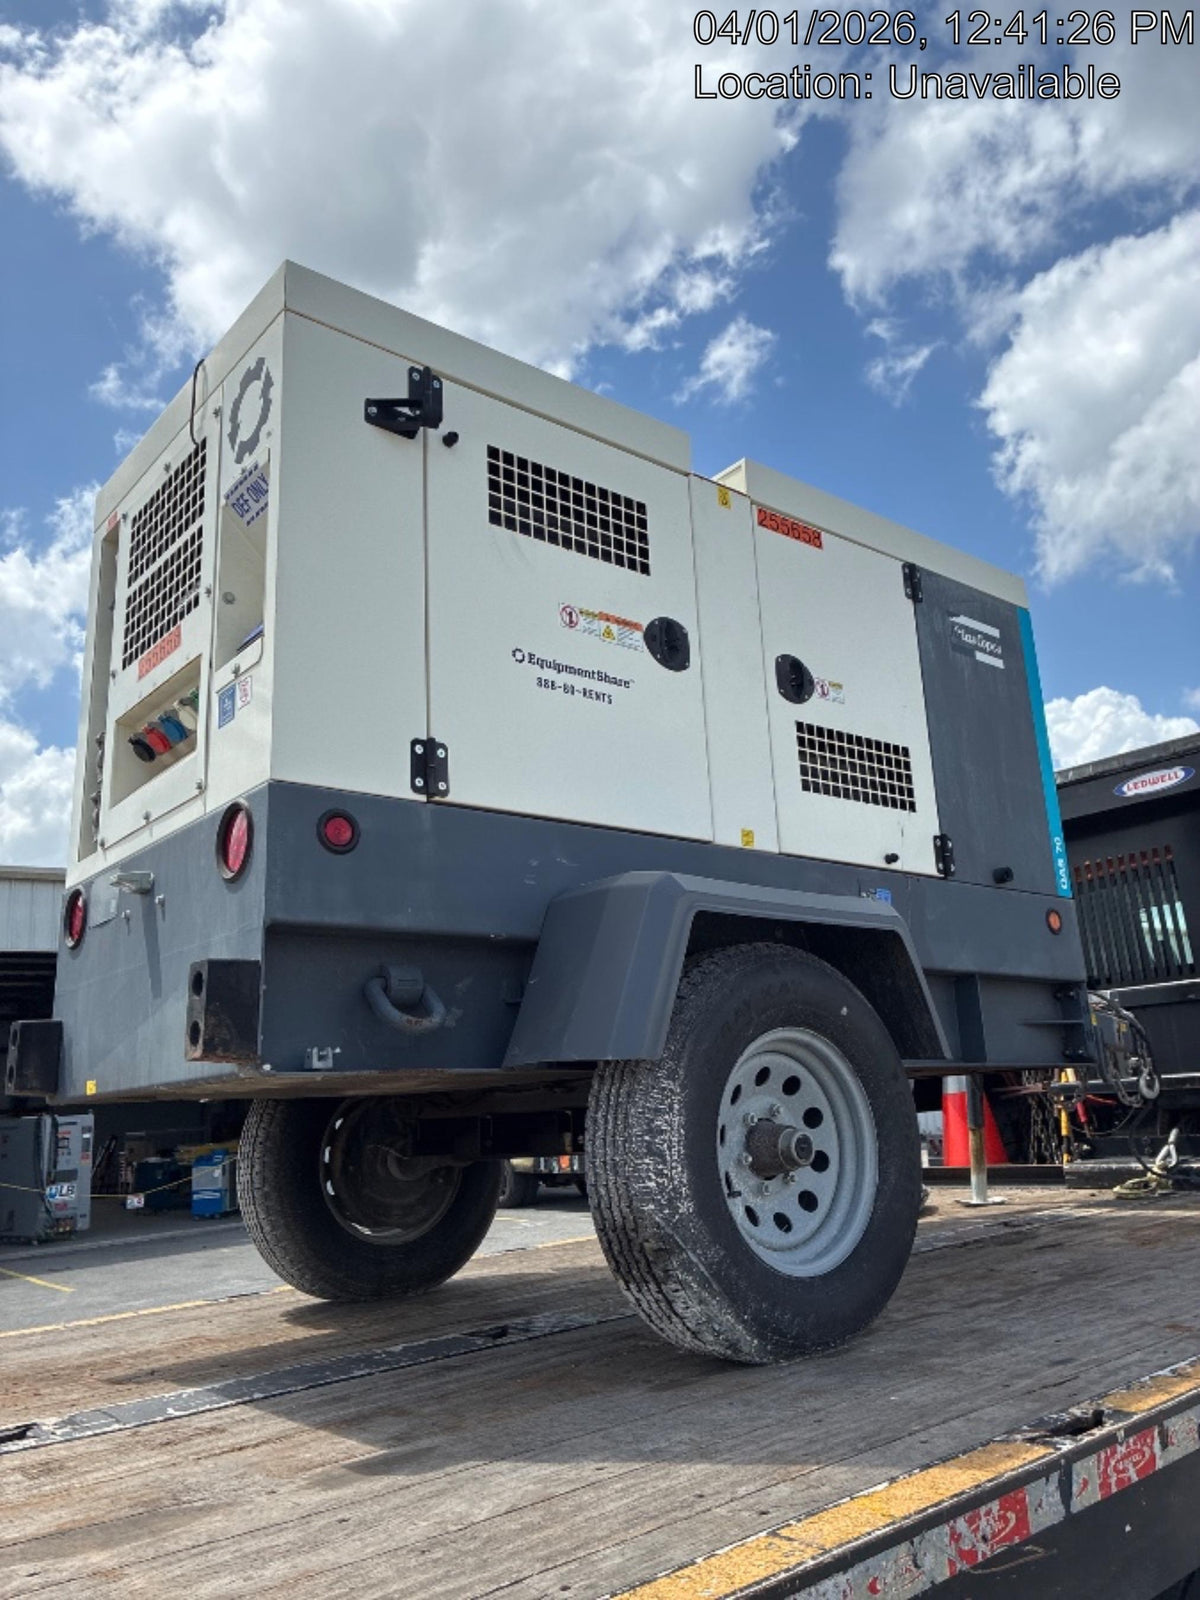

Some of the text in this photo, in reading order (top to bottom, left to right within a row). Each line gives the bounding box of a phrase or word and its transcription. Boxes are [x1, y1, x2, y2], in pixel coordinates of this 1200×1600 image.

[231, 472, 269, 519] DEF ONLY
[757, 508, 823, 550] 255658
[527, 652, 631, 689] EquipmentShare
[1126, 770, 1180, 792] LEDWELL
